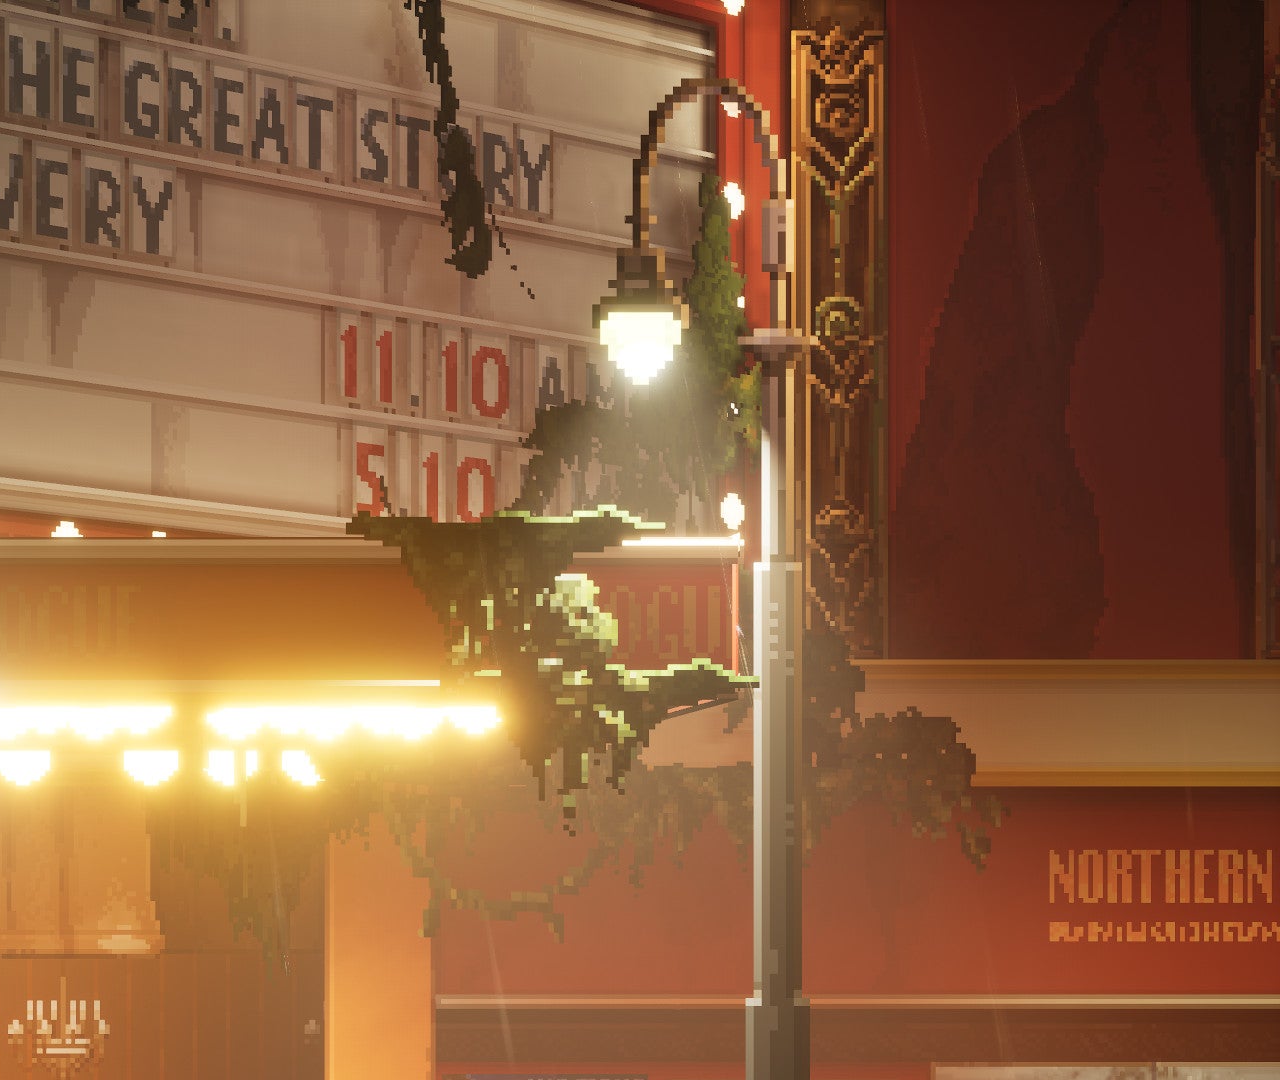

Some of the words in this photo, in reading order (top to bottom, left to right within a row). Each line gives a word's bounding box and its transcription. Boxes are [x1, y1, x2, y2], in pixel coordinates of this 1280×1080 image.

[123, 60, 334, 170] GREAT
[359, 108, 552, 214] STRY
[340, 324, 510, 420] 11.10
[356, 442, 496, 524] 5.10
[1049, 849, 1273, 904] NORTHERN
